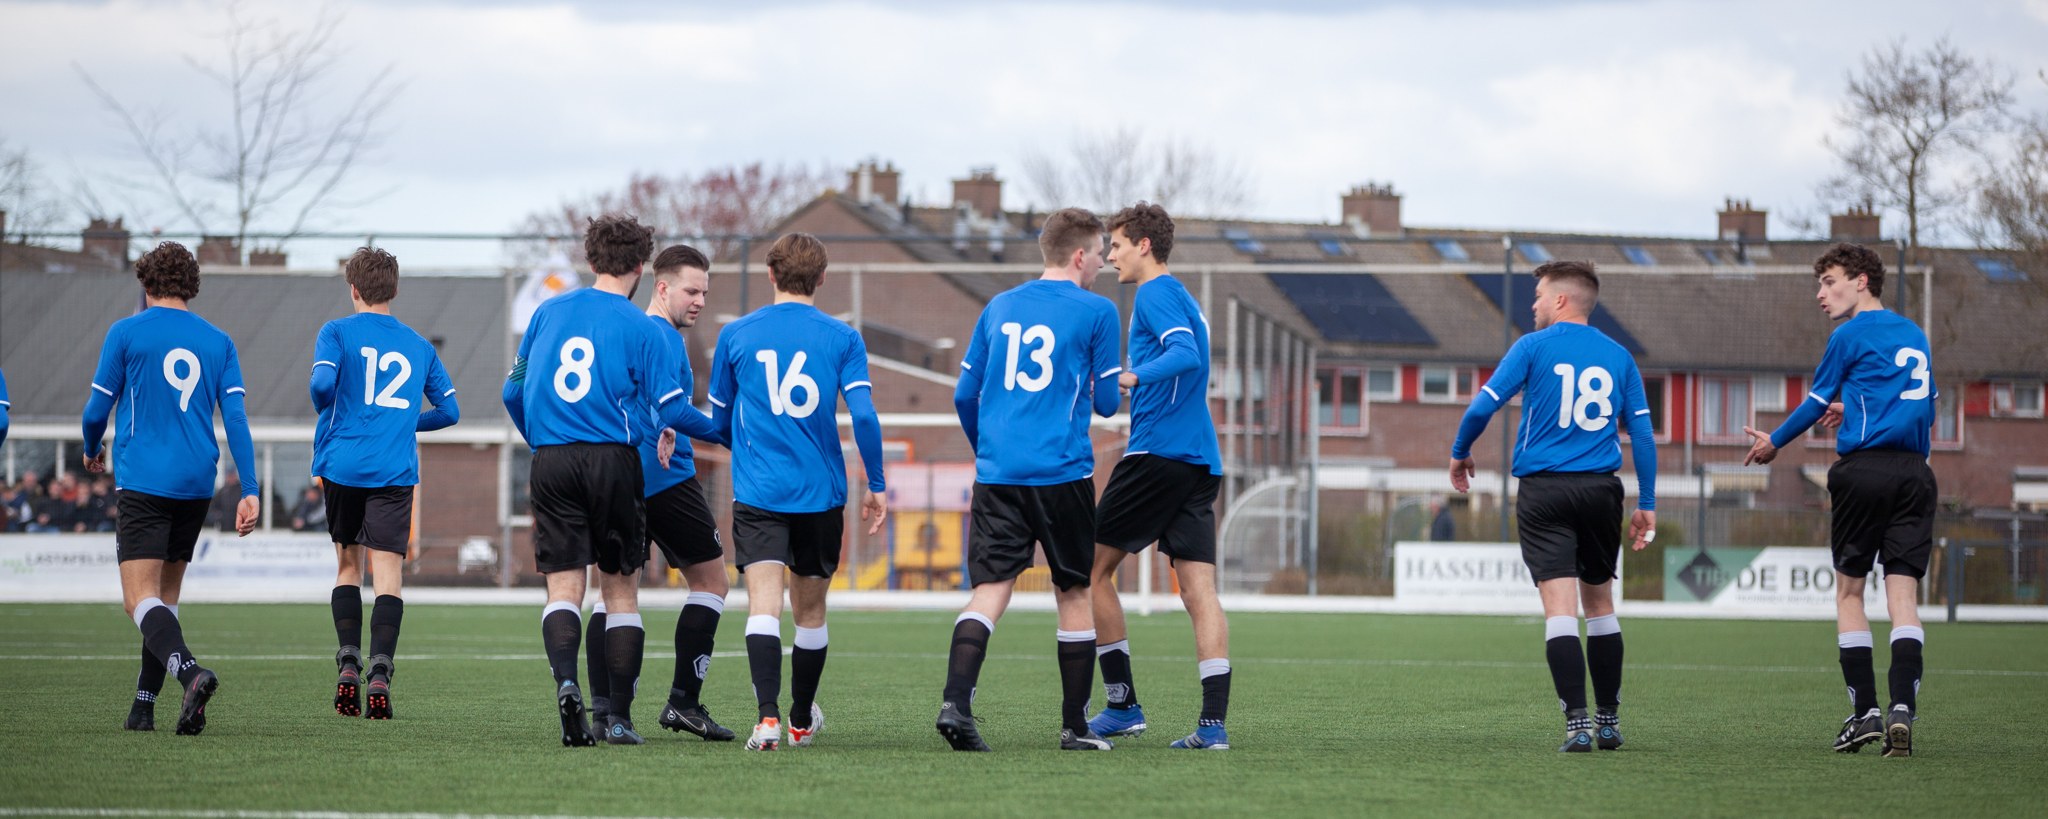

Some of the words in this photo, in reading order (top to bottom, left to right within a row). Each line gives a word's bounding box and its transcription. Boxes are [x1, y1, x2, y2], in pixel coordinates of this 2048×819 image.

[163, 348, 201, 412] 9
[360, 346, 412, 409] 12
[553, 336, 595, 403] 8
[756, 349, 820, 419] 16
[1001, 322, 1056, 391] 13
[1894, 346, 1930, 401] 3
[1553, 363, 1613, 432] 18
[1405, 557, 1528, 581] HASSEFR
[1737, 566, 1777, 590] DE
